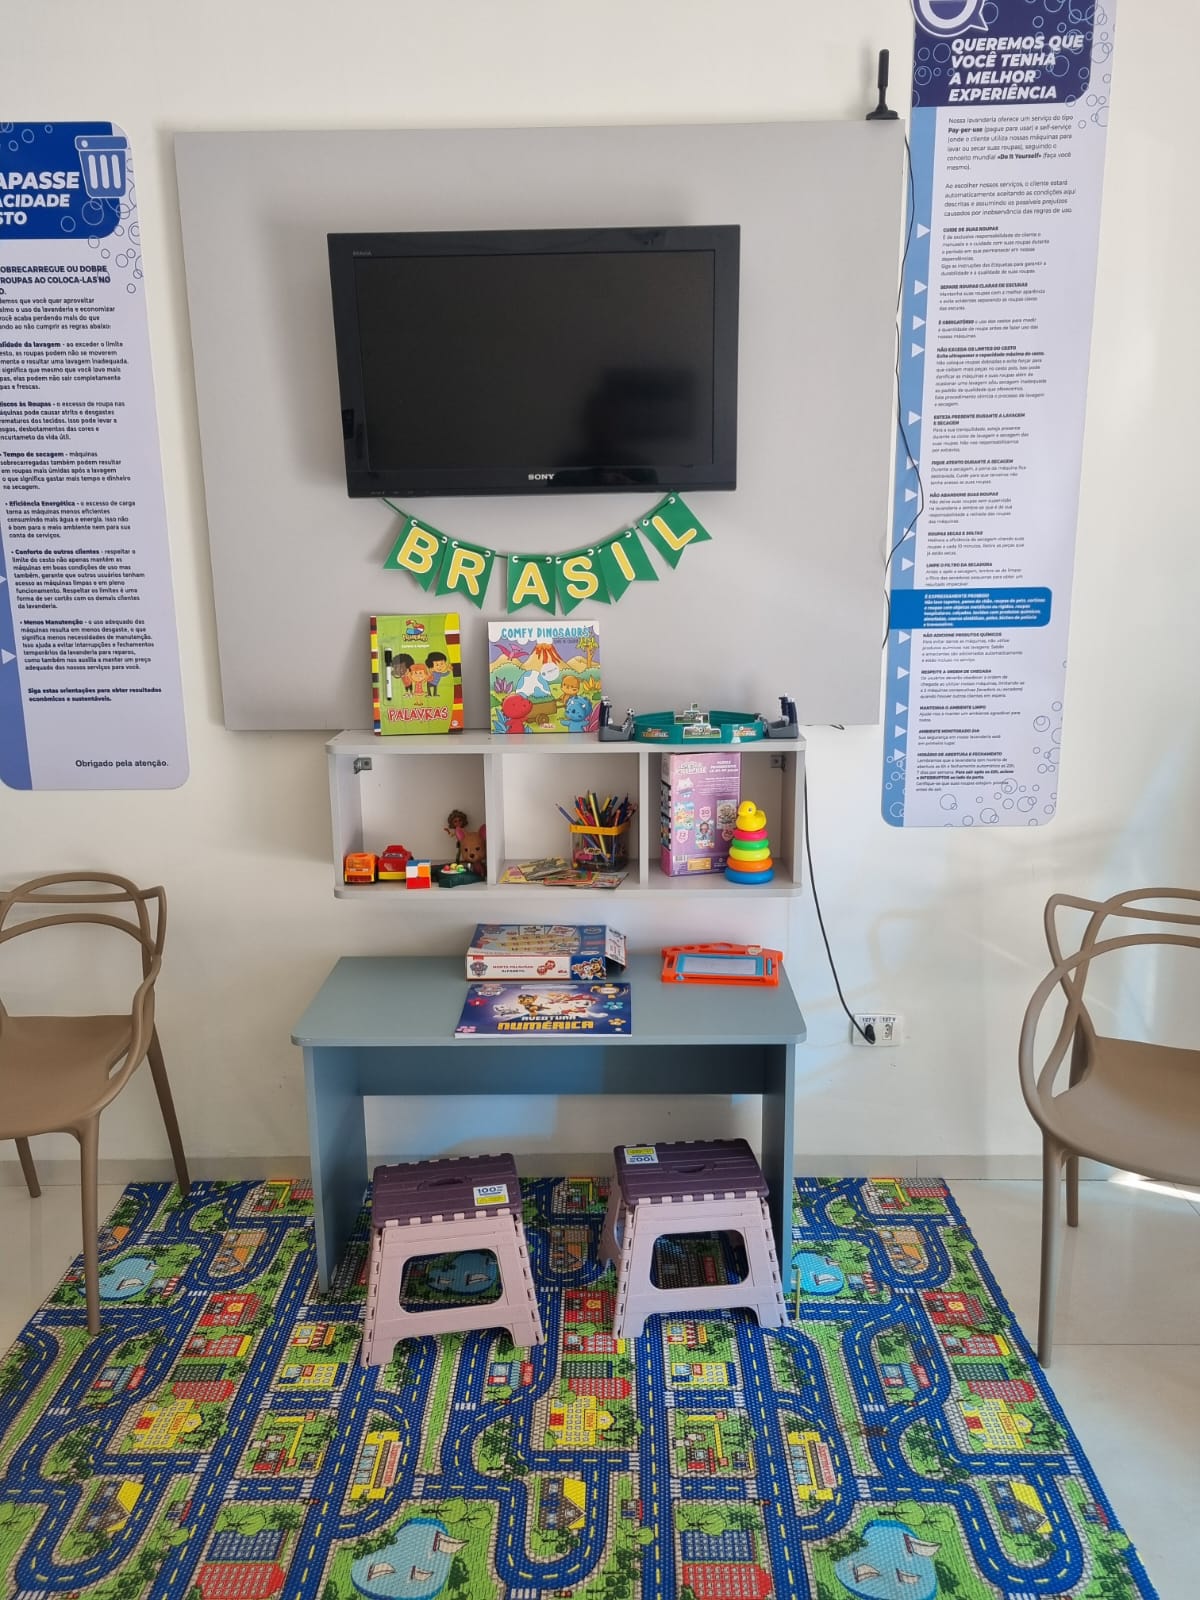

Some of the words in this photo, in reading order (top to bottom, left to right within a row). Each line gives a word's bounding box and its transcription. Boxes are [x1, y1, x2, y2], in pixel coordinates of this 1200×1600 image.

[951, 35, 1044, 53] QUEREMOS
[1049, 34, 1085, 51] QUE
[951, 51, 997, 69] VOCÊ
[1001, 52, 1056, 67] TENHA
[949, 73, 962, 85] A
[966, 69, 1035, 85] MELHOR
[949, 84, 1057, 102] EXPERIÊNCIA
[80, 265, 108, 273] DOBRE
[0, 276, 33, 284] ROUPAS
[34, 276, 46, 284] AO
[47, 276, 97, 284] COLOCA-LAS
[63, 297, 94, 305] aproveitar
[528, 473, 555, 481] SONY
[397, 515, 697, 605] BRASIL
[501, 627, 533, 639] COMFY
[536, 626, 591, 638] DINOSAURS
[28, 687, 41, 695] Siga
[60, 687, 96, 695] orientações
[387, 707, 448, 722] PALAVRAS
[75, 759, 113, 769] Obrigado
[115, 760, 133, 769] pela
[135, 759, 169, 769] atenção.
[497, 1019, 594, 1031] NUMÉRICA
[478, 1186, 496, 1195] 100
